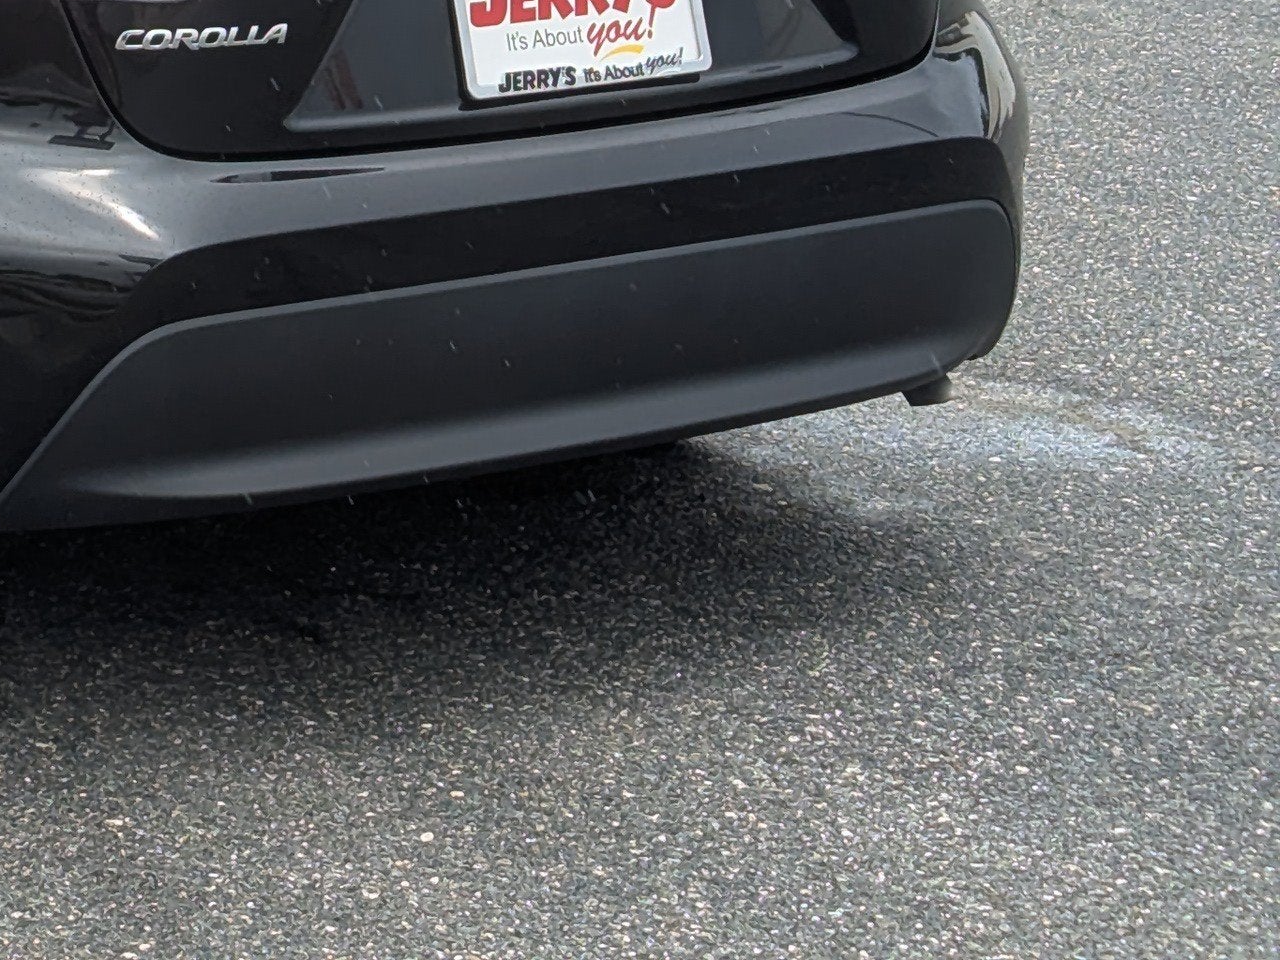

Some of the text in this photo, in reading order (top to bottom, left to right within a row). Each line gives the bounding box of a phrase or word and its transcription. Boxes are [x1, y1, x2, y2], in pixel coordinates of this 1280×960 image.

[114, 22, 288, 51] COROLLA
[506, 6, 656, 56] It's About you!
[498, 47, 684, 93] JERRY'S It's About you!
